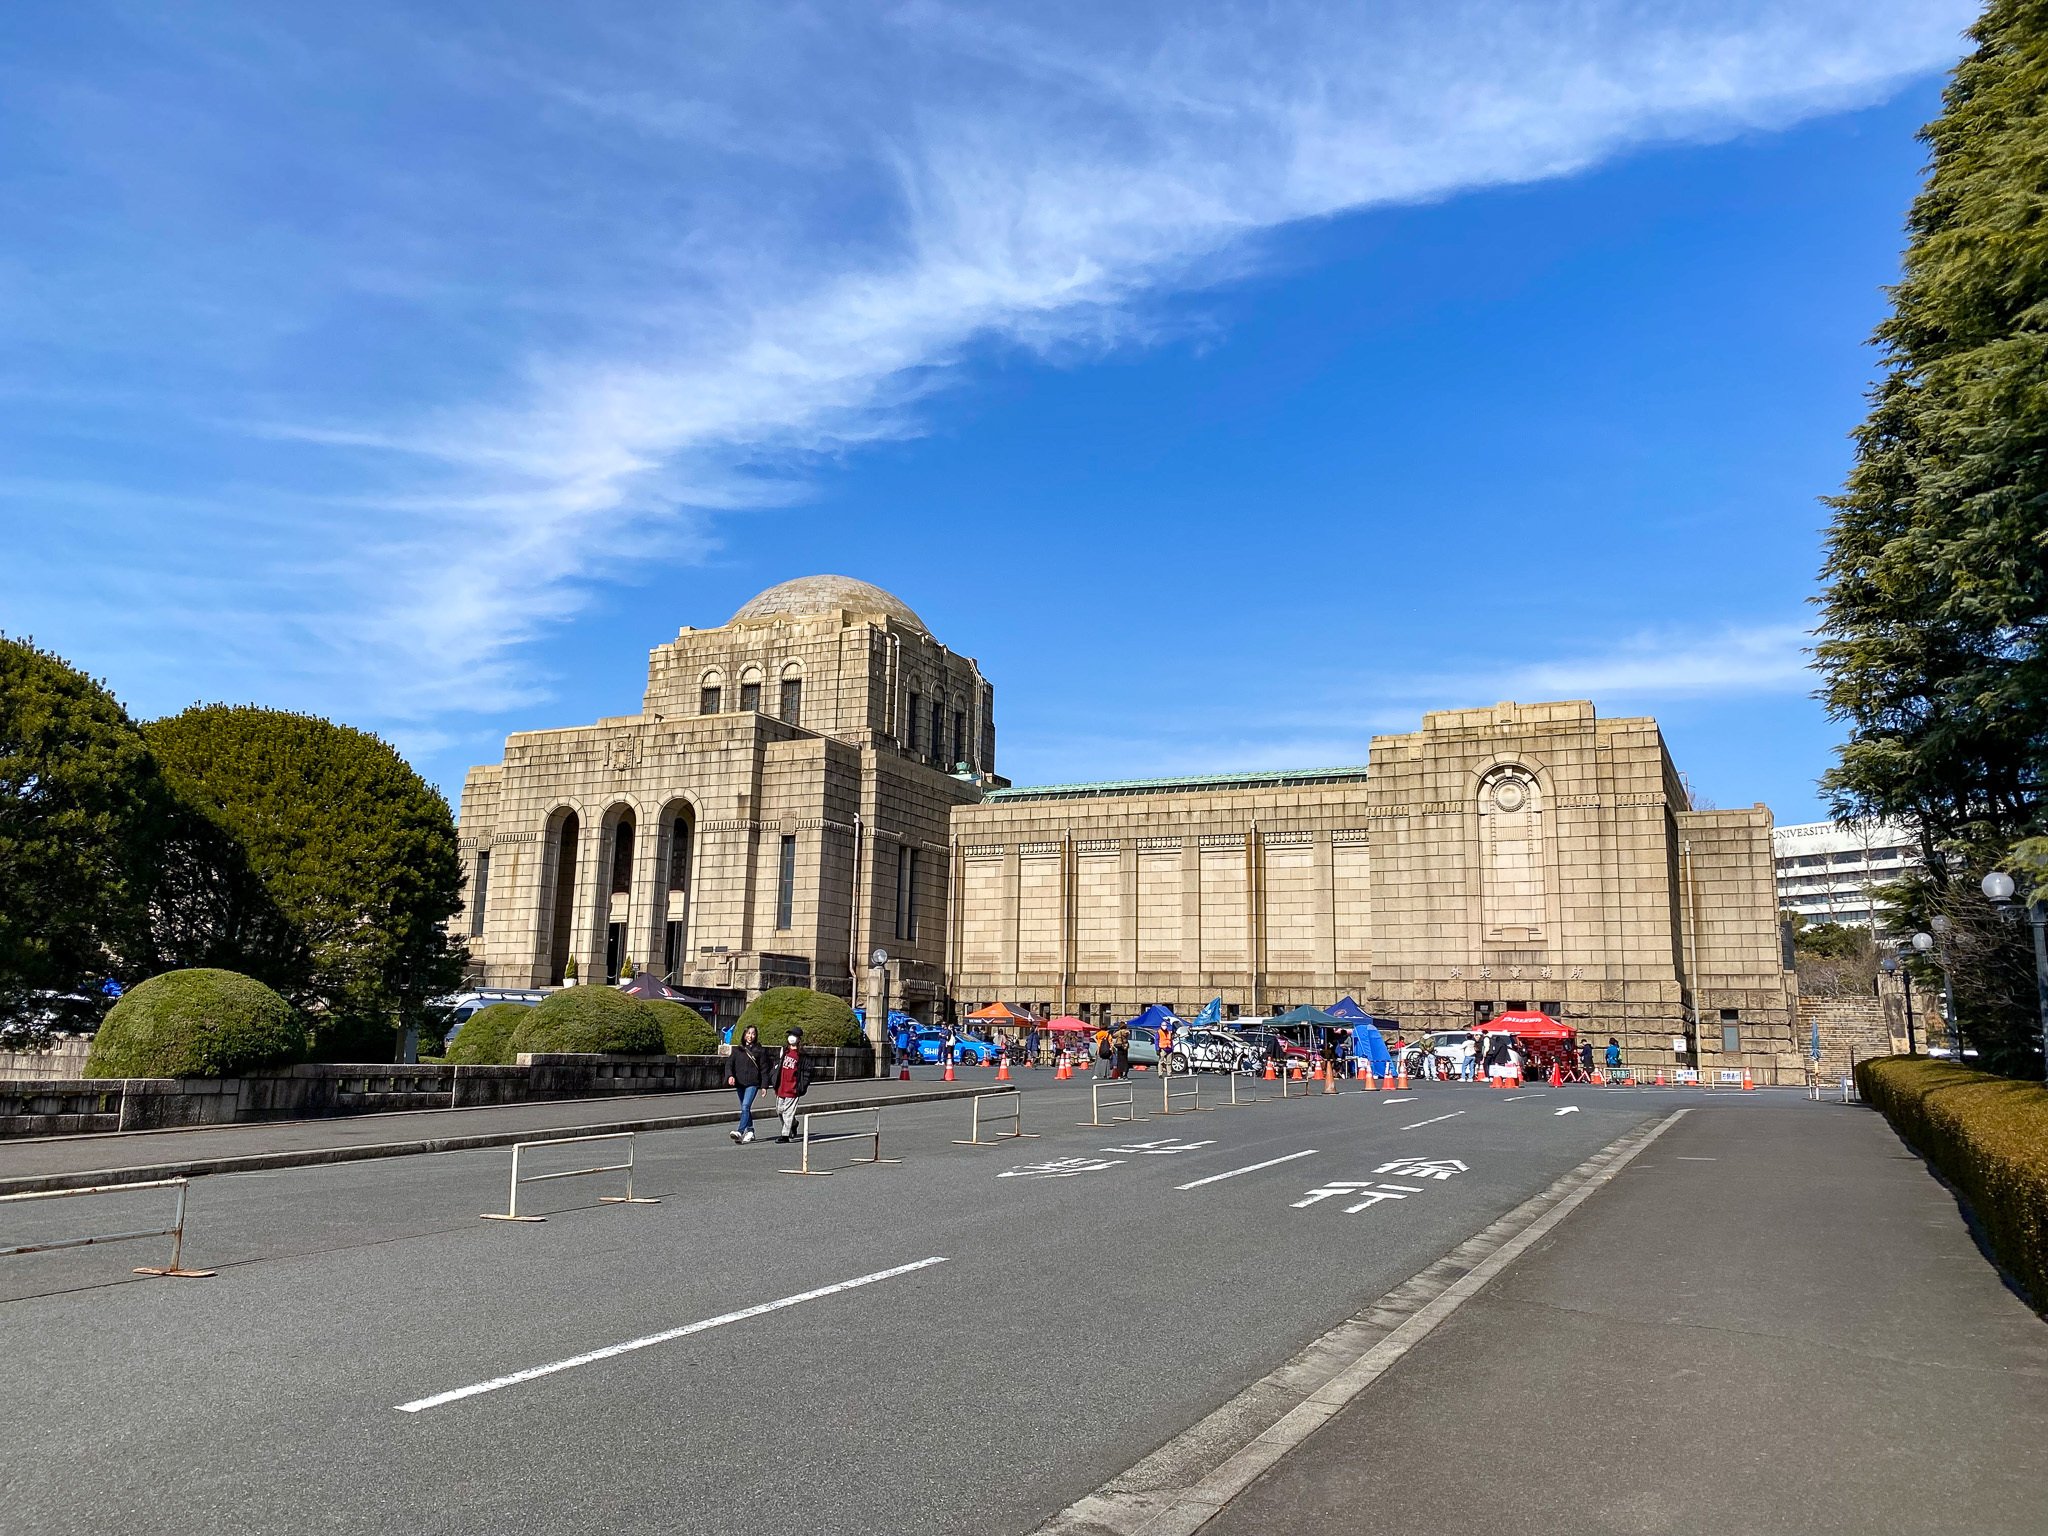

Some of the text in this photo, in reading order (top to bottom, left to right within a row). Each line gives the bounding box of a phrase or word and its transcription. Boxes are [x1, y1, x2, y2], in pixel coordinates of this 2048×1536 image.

[1772, 825, 1831, 839] UNIVERSITY
[1450, 965, 1584, 979] 外苑事務所
[1289, 1156, 1470, 1213] 徐行
